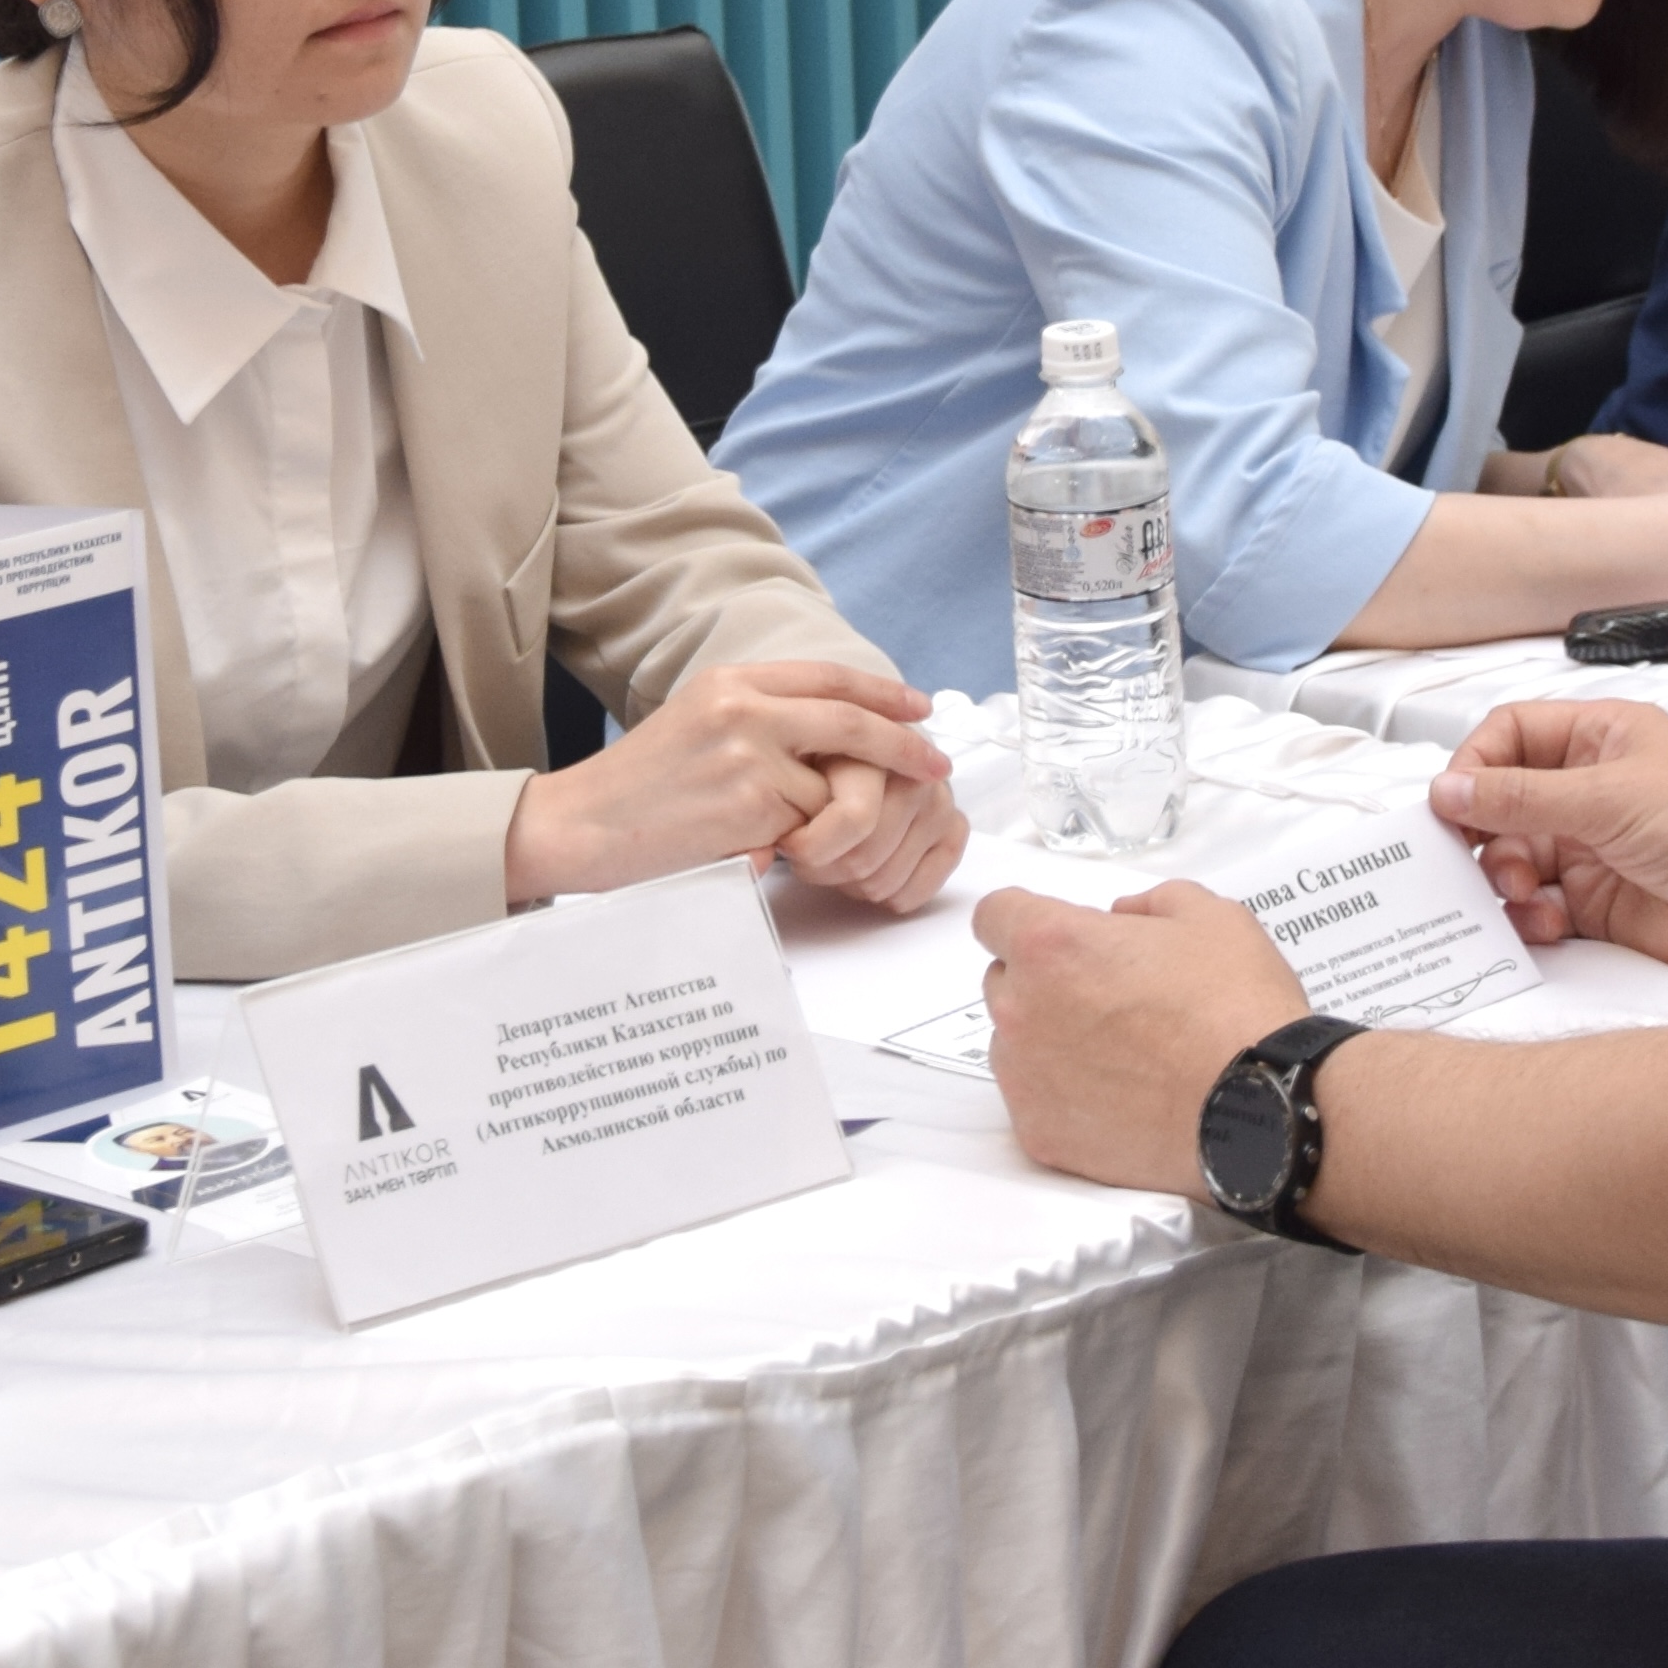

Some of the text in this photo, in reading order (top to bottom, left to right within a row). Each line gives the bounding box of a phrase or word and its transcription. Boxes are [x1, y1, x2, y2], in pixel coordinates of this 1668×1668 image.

[6, 553, 94, 584] ПРОТИВОДЕЙСТВИЮ
[13, 546, 71, 568] РЕСПУБЛИКИ
[73, 532, 122, 552] КАЗАХСТАН
[16, 575, 71, 596] КОРРУПЦИИ
[57, 676, 154, 1049] ANTIKOR
[1296, 841, 1413, 894] Сагыныш
[1263, 890, 1379, 945] ериковна
[1328, 934, 1395, 969] руководителя
[1396, 909, 1463, 942] Департамента
[1333, 961, 1385, 984] Казахстан
[1413, 955, 1452, 976] области
[496, 975, 717, 1046] Департамент Агентства
[496, 1000, 734, 1074] Республики Казахстан по
[488, 1023, 760, 1109] противодействию коррупции
[476, 1046, 788, 1143] (Антикоррупционной службы) по
[541, 1087, 746, 1155] Акмолинской области
[344, 1138, 452, 1184] ANTIKOR
[375, 1176, 406, 1195] МЕН
